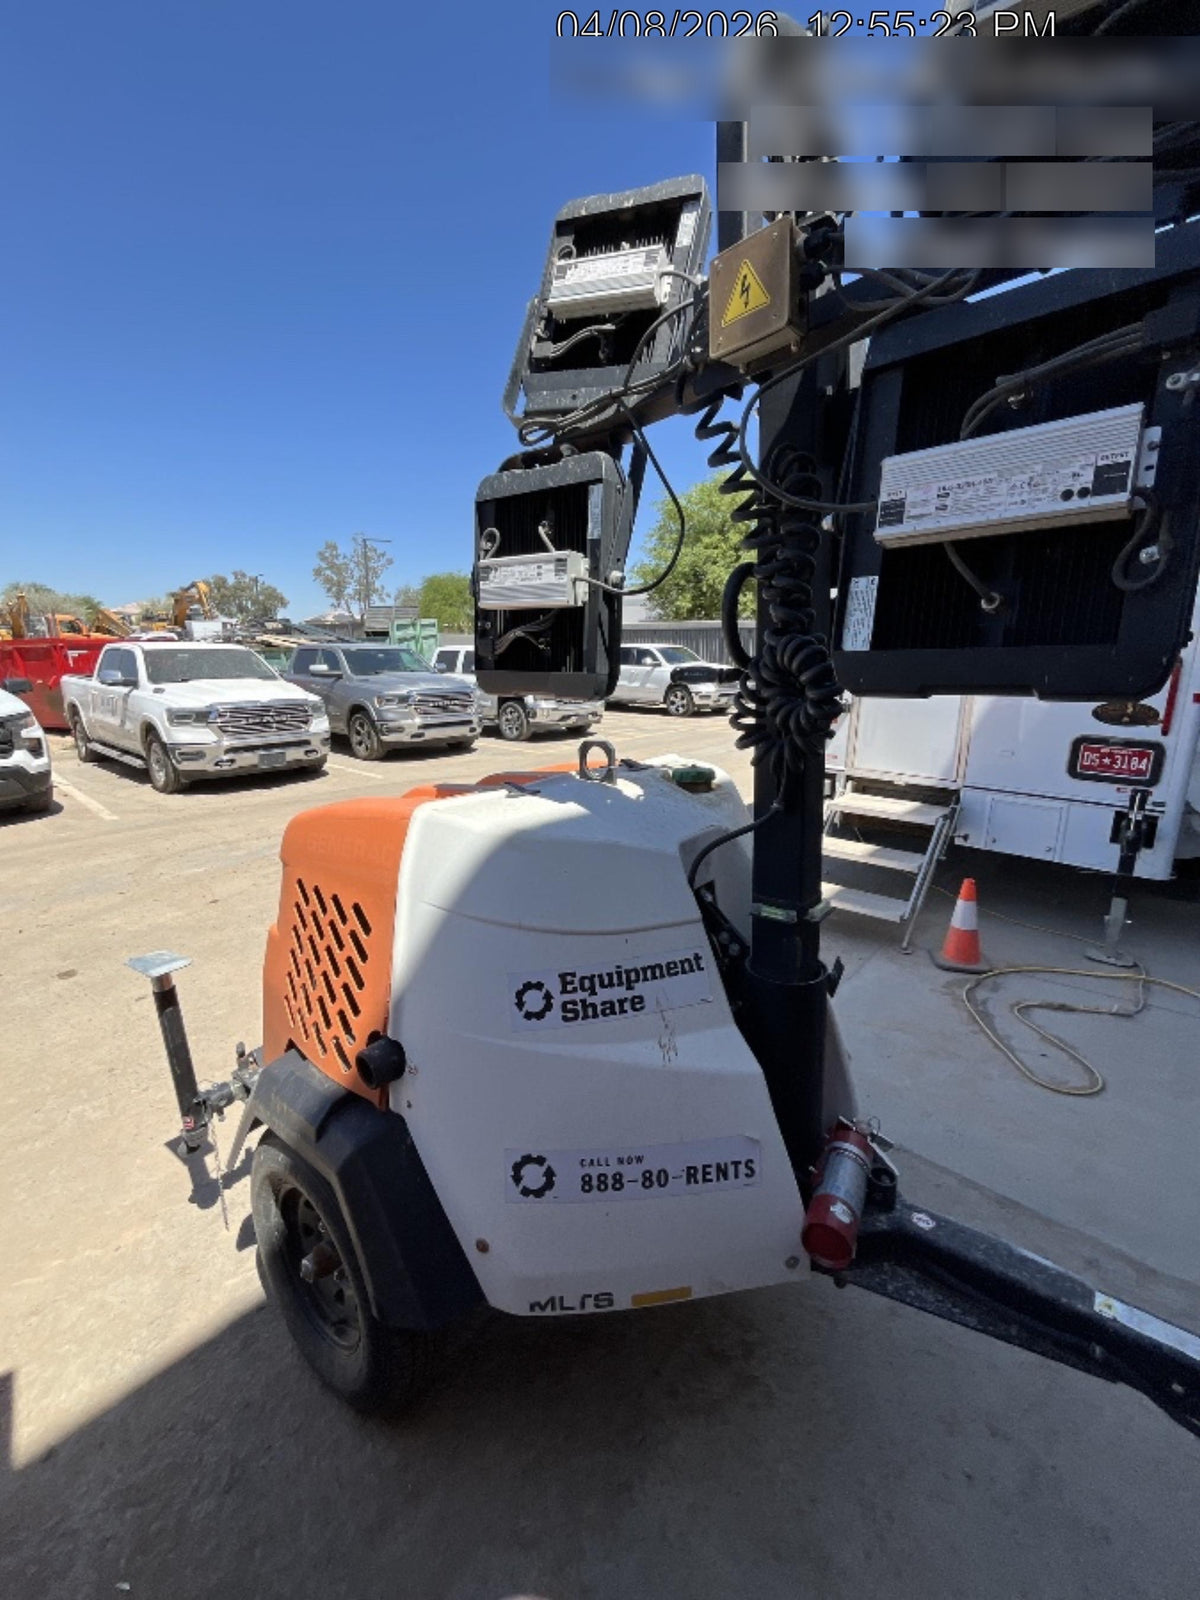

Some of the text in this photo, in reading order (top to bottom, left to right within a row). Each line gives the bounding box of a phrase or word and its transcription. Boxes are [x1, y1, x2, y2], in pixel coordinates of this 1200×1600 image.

[558, 952, 705, 996] Equipment
[561, 994, 645, 1023] Share
[579, 1154, 644, 1168] CALL NOW
[580, 1158, 756, 1194] 888-80-RENTS
